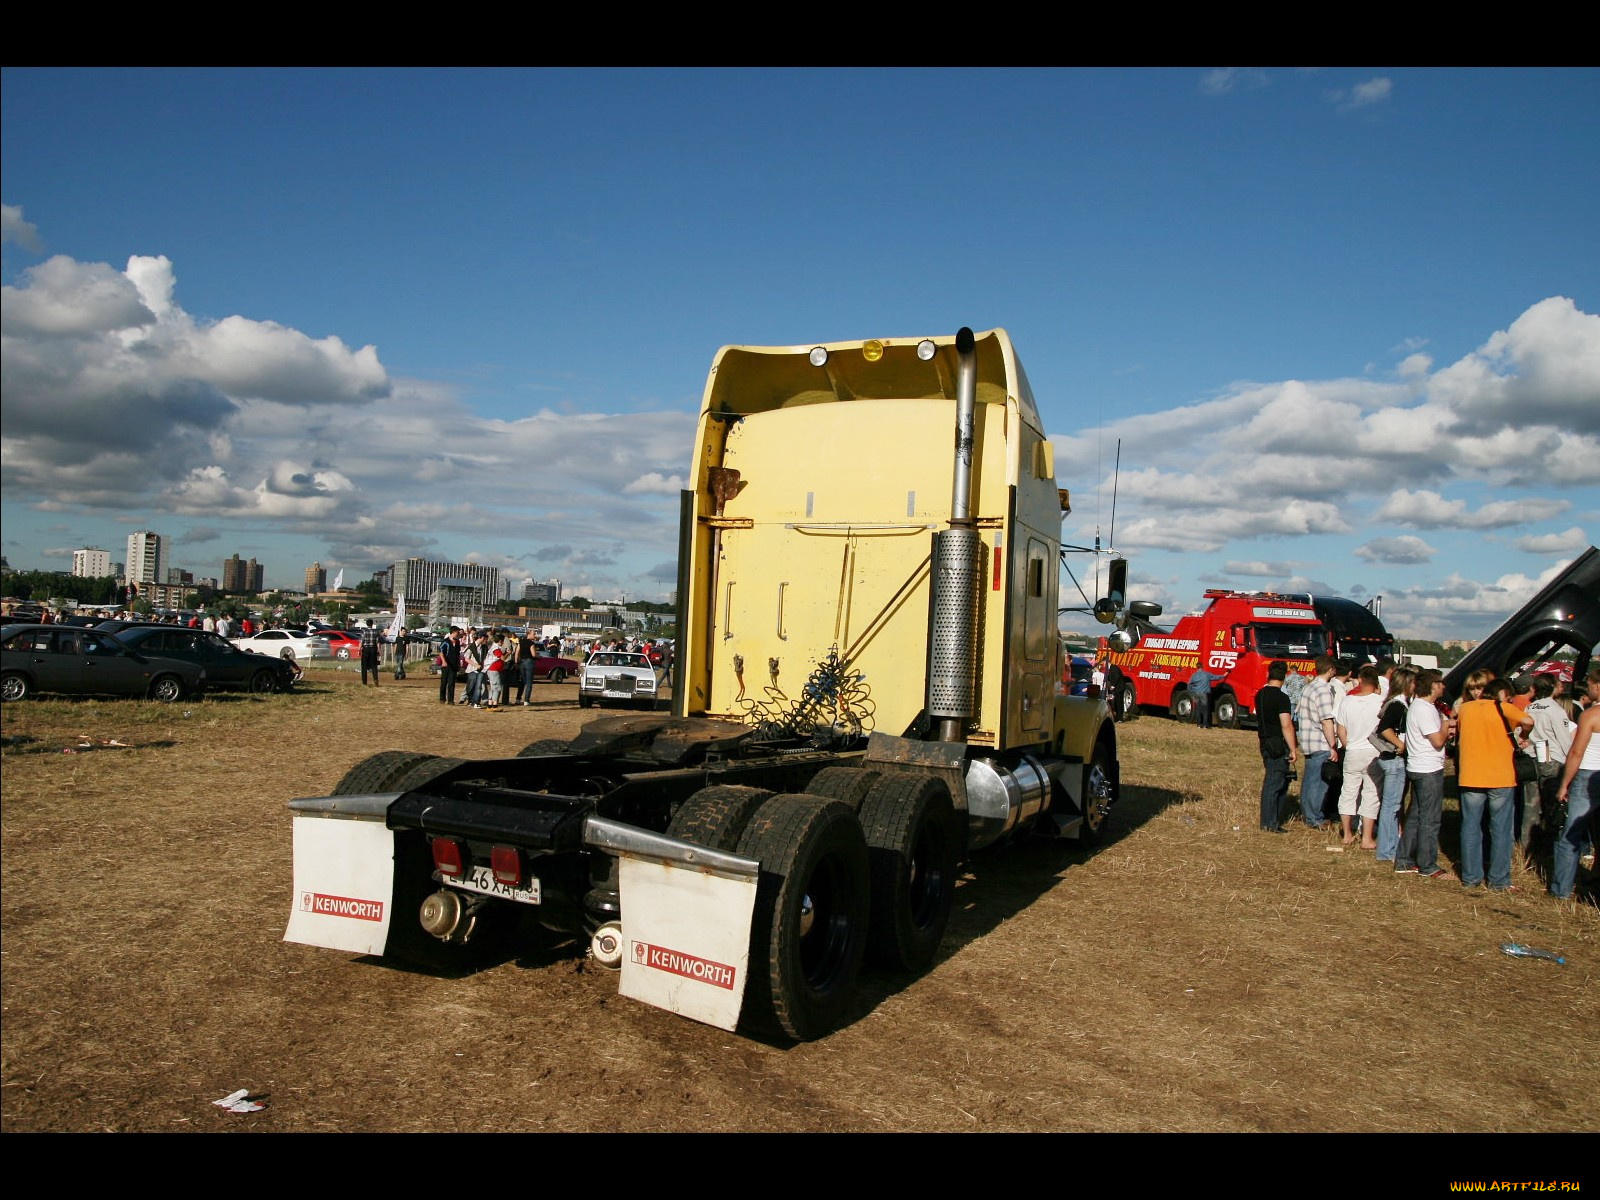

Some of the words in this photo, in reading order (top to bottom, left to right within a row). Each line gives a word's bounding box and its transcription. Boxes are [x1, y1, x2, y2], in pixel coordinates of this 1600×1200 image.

[1216, 631, 1226, 641] 24
[1208, 655, 1238, 669] GTS
[515, 891, 529, 900] RUS
[315, 897, 381, 918] KENWORTH
[651, 949, 732, 985] KENWORTH
